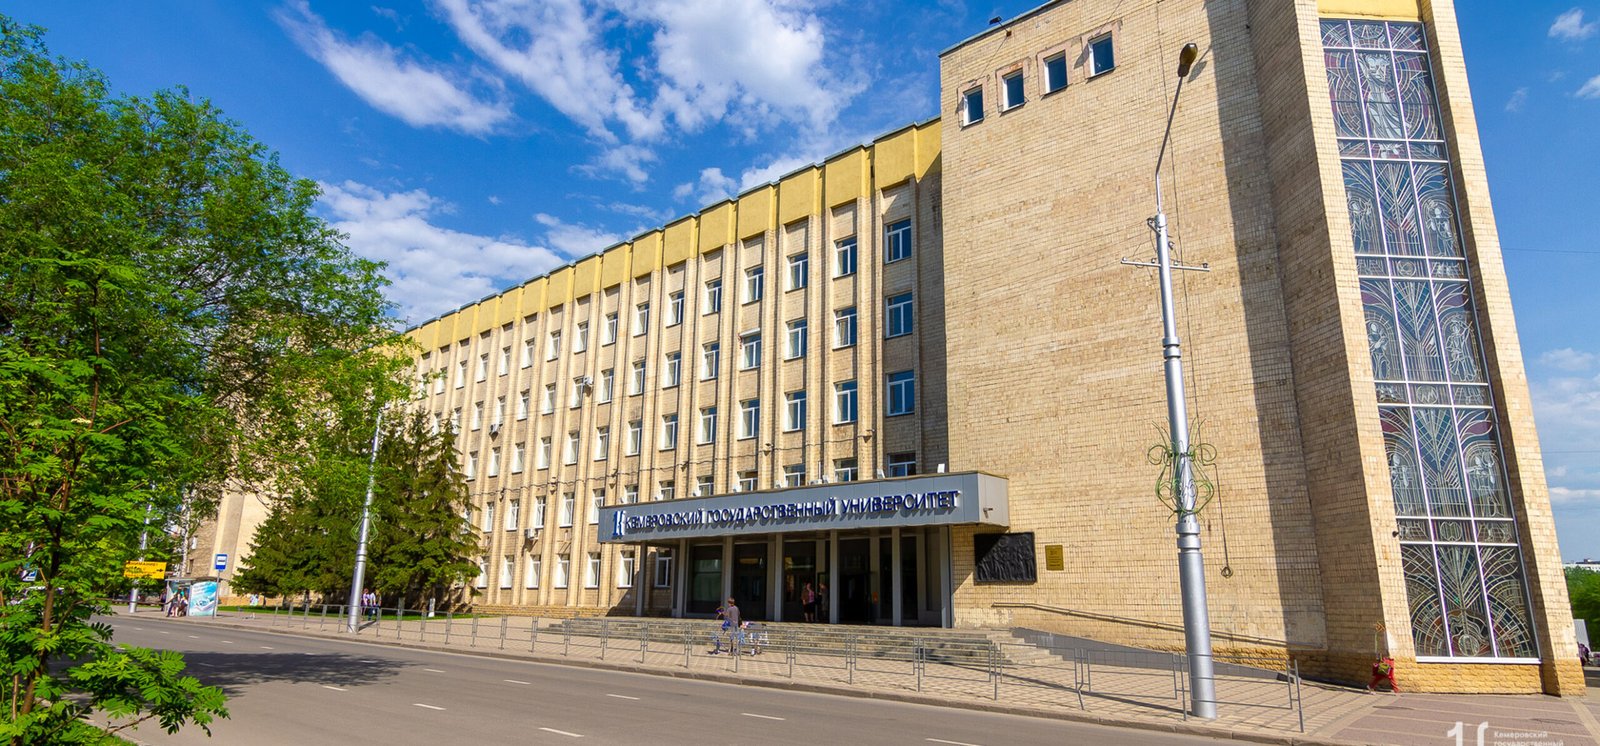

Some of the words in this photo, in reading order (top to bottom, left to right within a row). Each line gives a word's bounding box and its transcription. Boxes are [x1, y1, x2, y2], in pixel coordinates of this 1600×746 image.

[625, 508, 705, 529] КЕМЕРОВСКИЙ
[706, 498, 840, 524] ГОСУДАРСТВЕННЫЙ
[841, 490, 960, 515] УНИВЕРСИТЕТ
